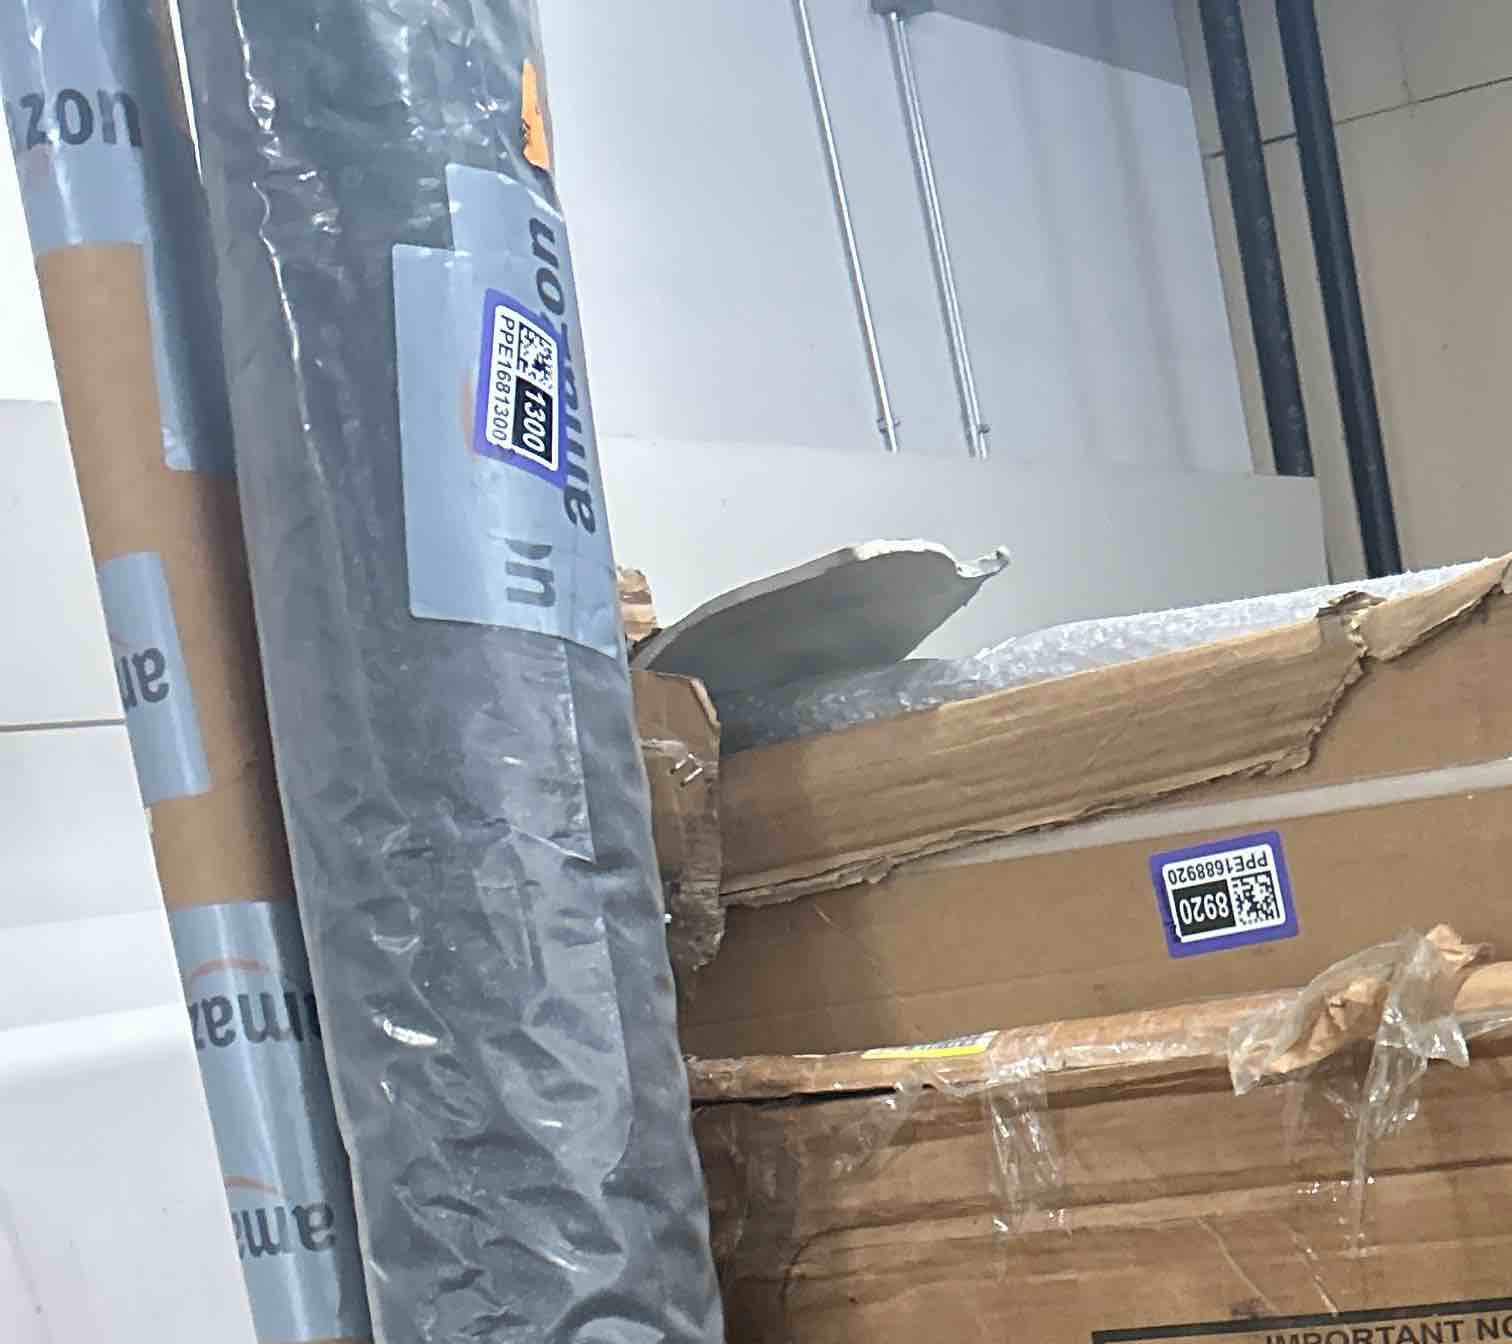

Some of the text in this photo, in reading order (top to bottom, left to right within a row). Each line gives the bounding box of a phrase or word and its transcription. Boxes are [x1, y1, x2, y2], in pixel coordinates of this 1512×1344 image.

[491, 313, 516, 442] PPE1681300
[521, 389, 547, 454] 1300
[1167, 849, 1269, 885] PPE1688920
[1178, 891, 1230, 925] 8920
